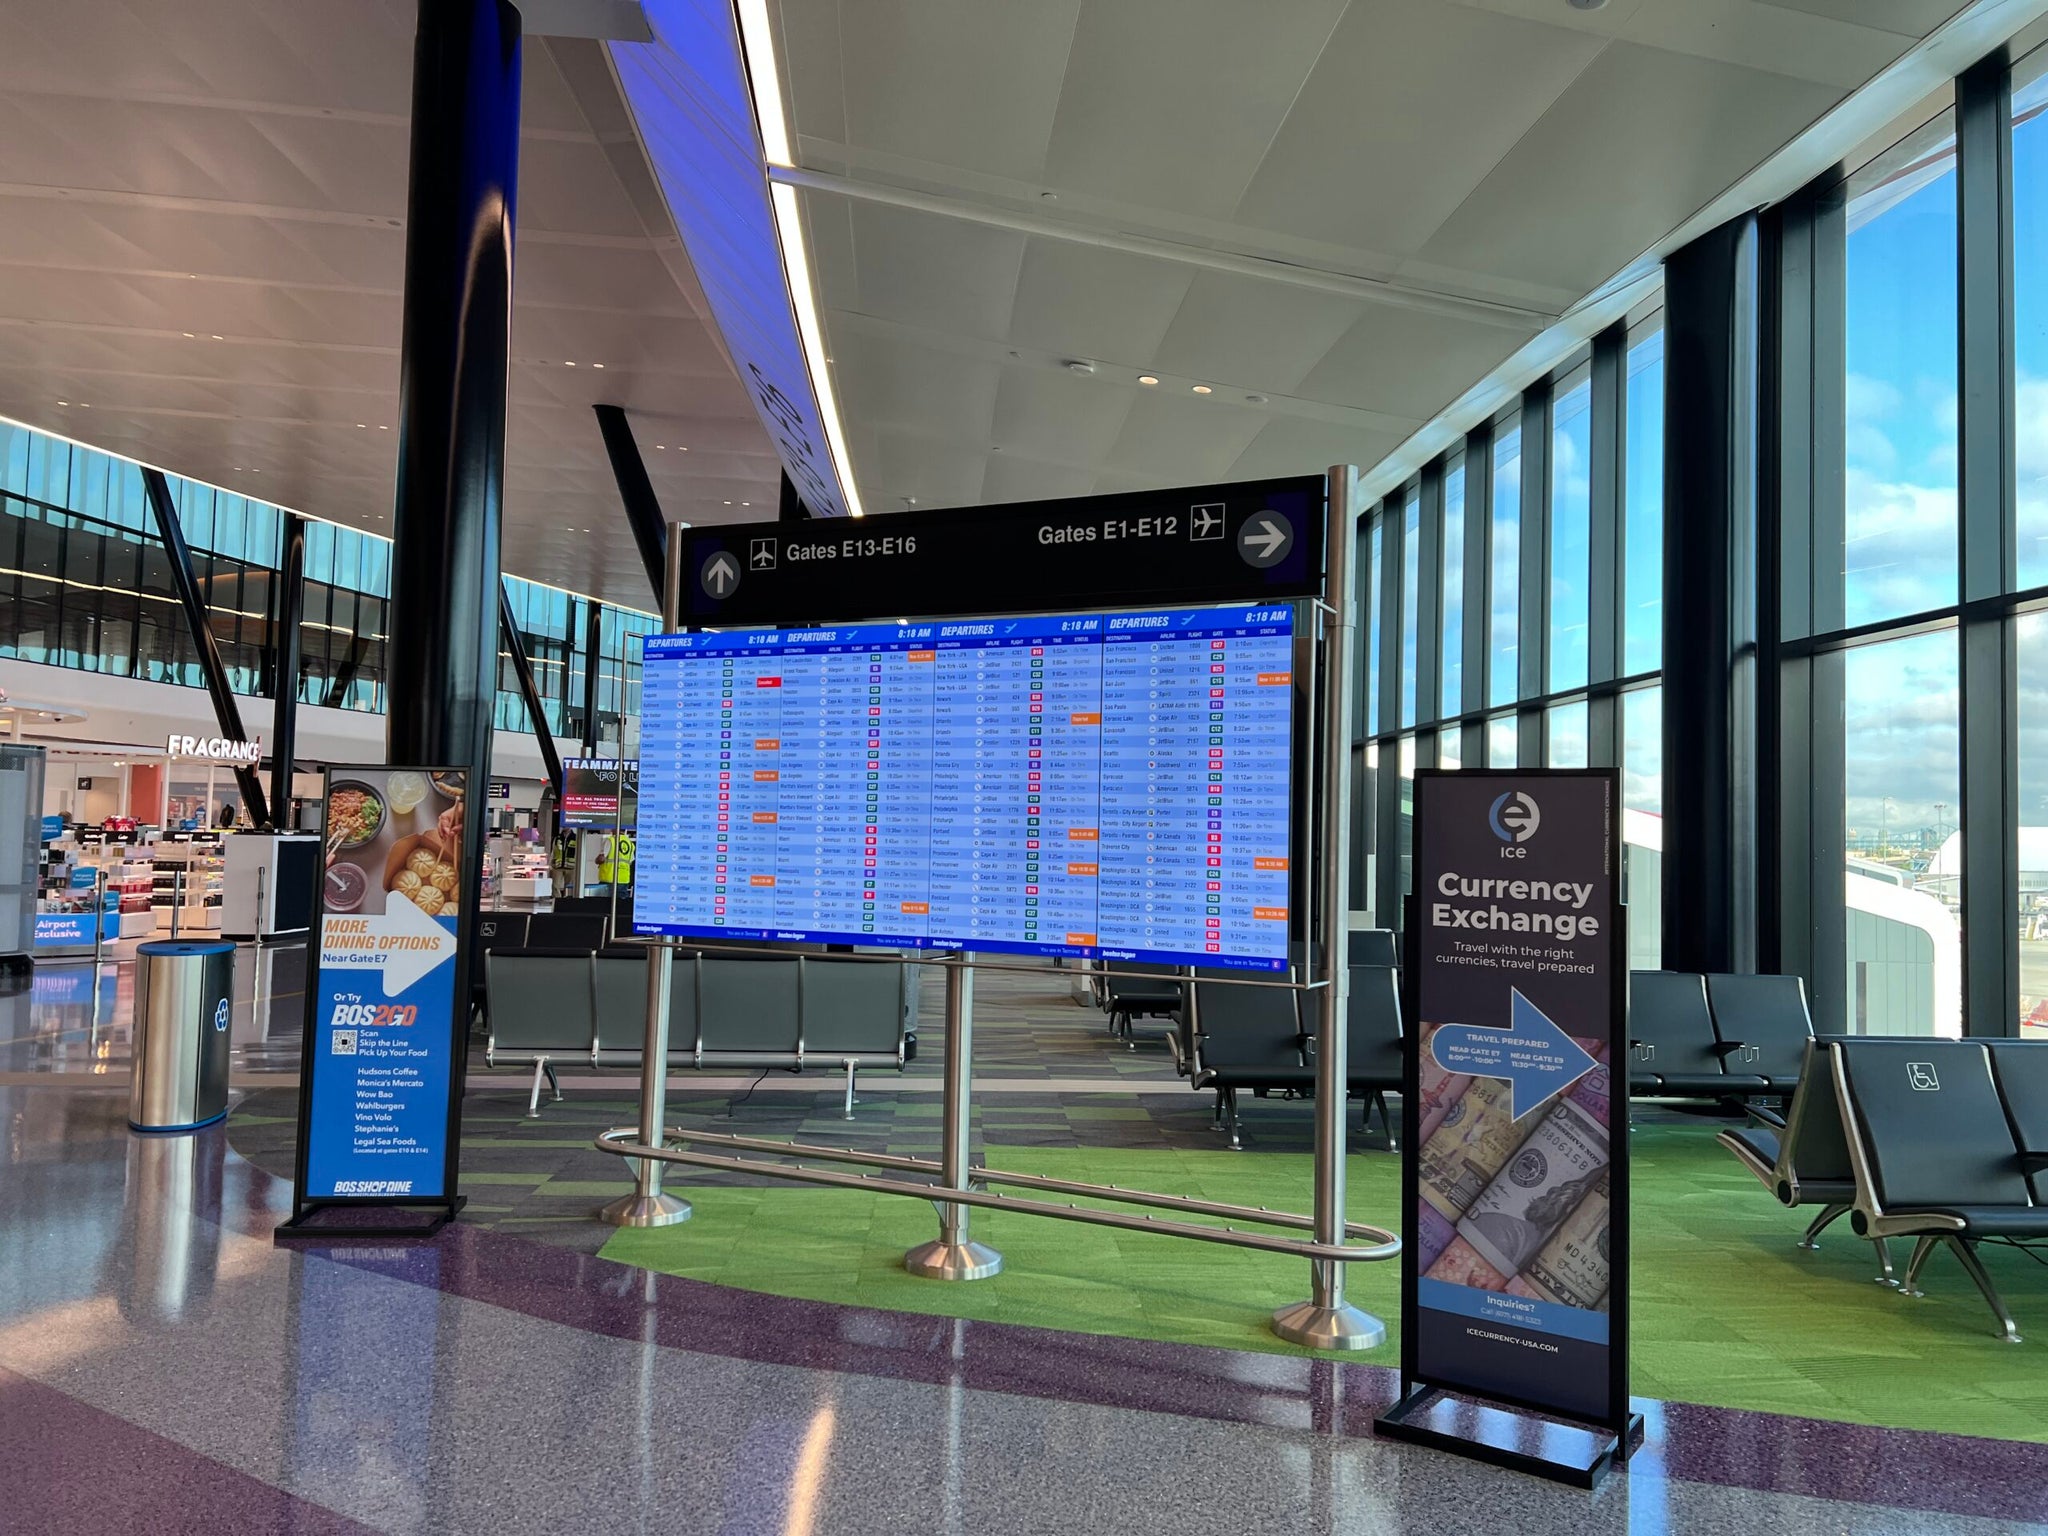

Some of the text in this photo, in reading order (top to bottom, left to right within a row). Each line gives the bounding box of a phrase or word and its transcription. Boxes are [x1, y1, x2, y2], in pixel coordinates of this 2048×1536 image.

[1038, 516, 1177, 544] Gates E1-E12
[786, 536, 916, 561] Gates E13-E16
[1245, 610, 1287, 623] 8:18 AM
[1061, 620, 1098, 631] 8:18 AM
[1110, 616, 1169, 629] DEPARTURES
[898, 628, 931, 638] 8:18 AM
[941, 624, 994, 636] DEPARTURES
[647, 637, 692, 648] DEPARTURES
[748, 634, 778, 644] 8:18 AM
[787, 632, 836, 642] DEPARTURES
[167, 734, 259, 761] FRAGRANCE
[1438, 872, 1594, 909] Currency
[37, 920, 77, 930] Airport
[324, 920, 368, 933] MORE
[1432, 903, 1599, 941] Exchange
[34, 930, 81, 938] Exclusive
[324, 935, 441, 950] DINING OPTIONS
[1454, 941, 1574, 961] Travel with the right
[322, 954, 388, 963] Near Gate E7
[1436, 954, 1595, 974] currencies, travel prepared
[333, 993, 362, 1003] Or Try
[331, 1004, 417, 1026] BOS2GO
[360, 1039, 408, 1047] Skip the Line
[1466, 1034, 1550, 1049] TRAVEL PREPARED
[359, 1048, 428, 1058] Pick Up Your Food
[1470, 1048, 1490, 1056] GATE
[1510, 1052, 1531, 1060] NEAR
[1532, 1054, 1553, 1063] GATE
[392, 1068, 418, 1076] Coffee
[357, 1079, 391, 1087] Monica's
[356, 1102, 405, 1112] Wahlburgers
[355, 1113, 372, 1121] Vino
[354, 1125, 399, 1134] Stephanie's
[354, 1138, 375, 1147] Legal
[1487, 1295, 1535, 1312] Inquiries?
[1466, 1327, 1558, 1354] ICECURRENCY-USA.COM
